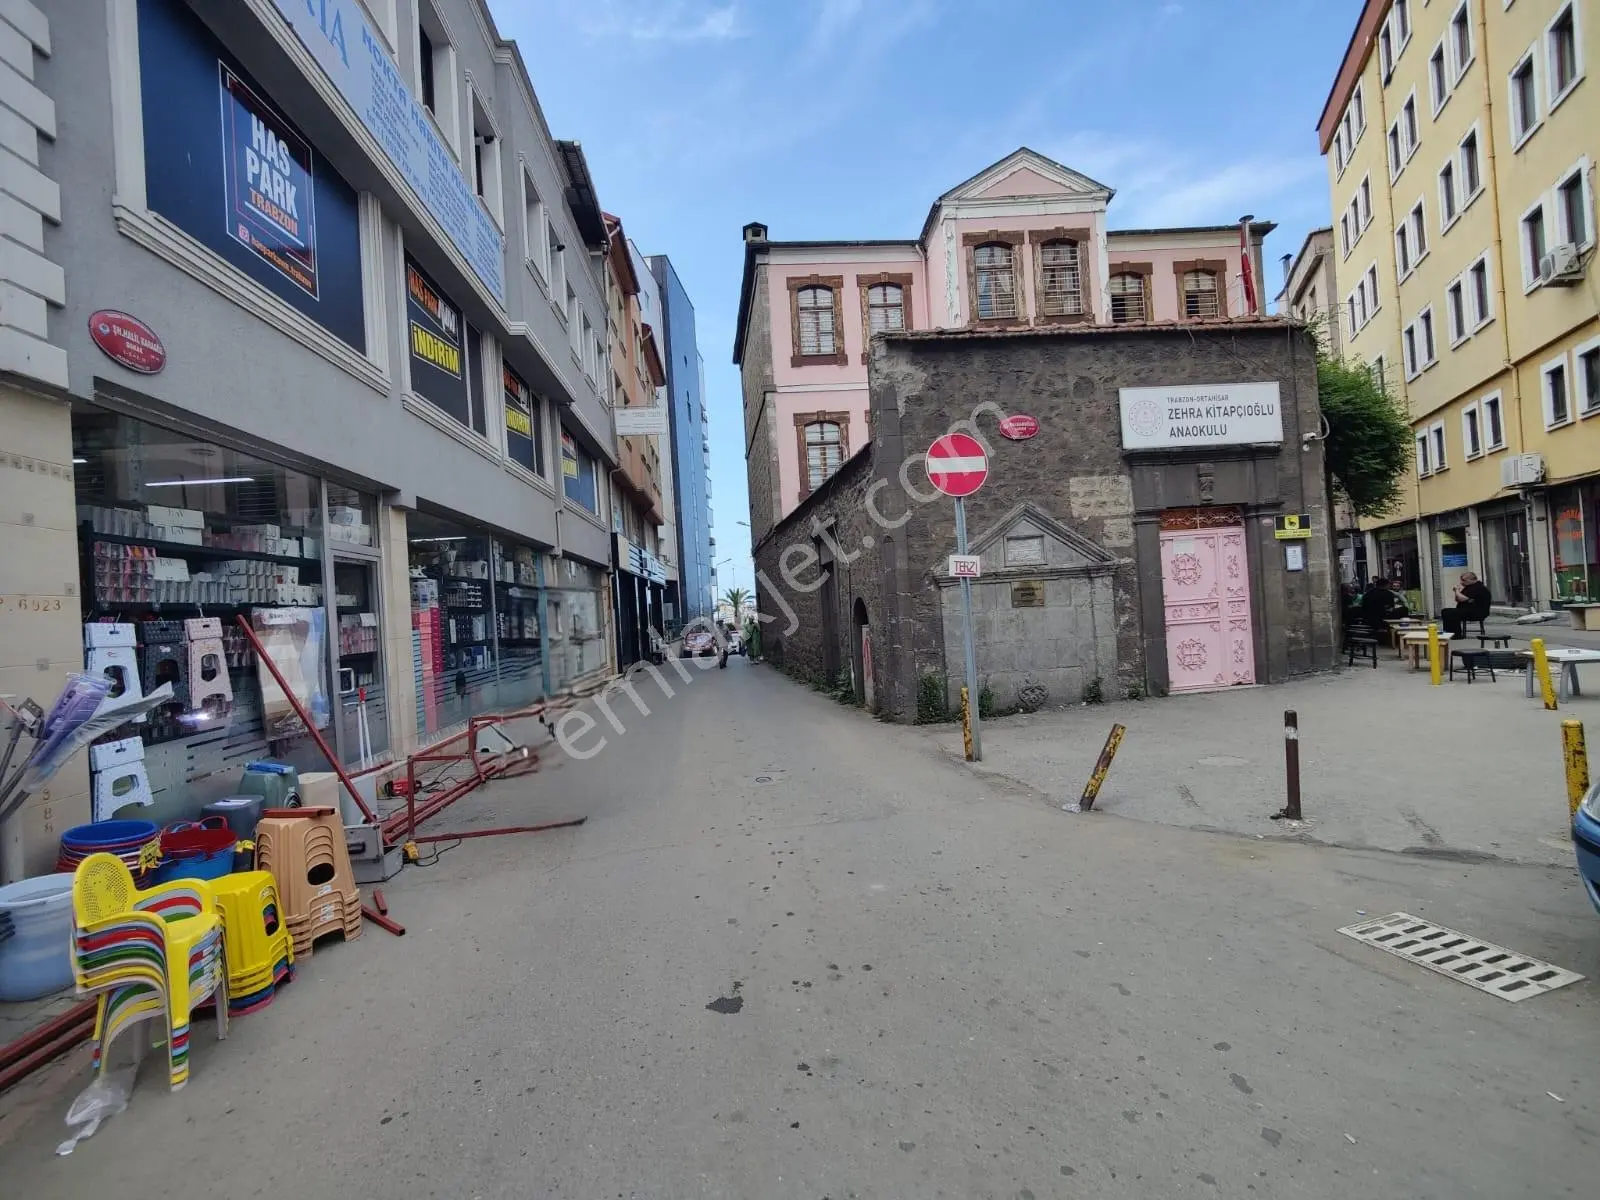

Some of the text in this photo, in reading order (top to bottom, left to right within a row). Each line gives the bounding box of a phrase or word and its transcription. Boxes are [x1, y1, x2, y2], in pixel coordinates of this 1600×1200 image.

[251, 113, 290, 177] HAS
[246, 145, 298, 219] PARK
[250, 187, 298, 237] TRABZON
[411, 324, 460, 374] İNDİRİM
[1168, 402, 1275, 420] ZEHRA KİTAPÇIOĞLU
[1169, 423, 1228, 438] ANAOKULU
